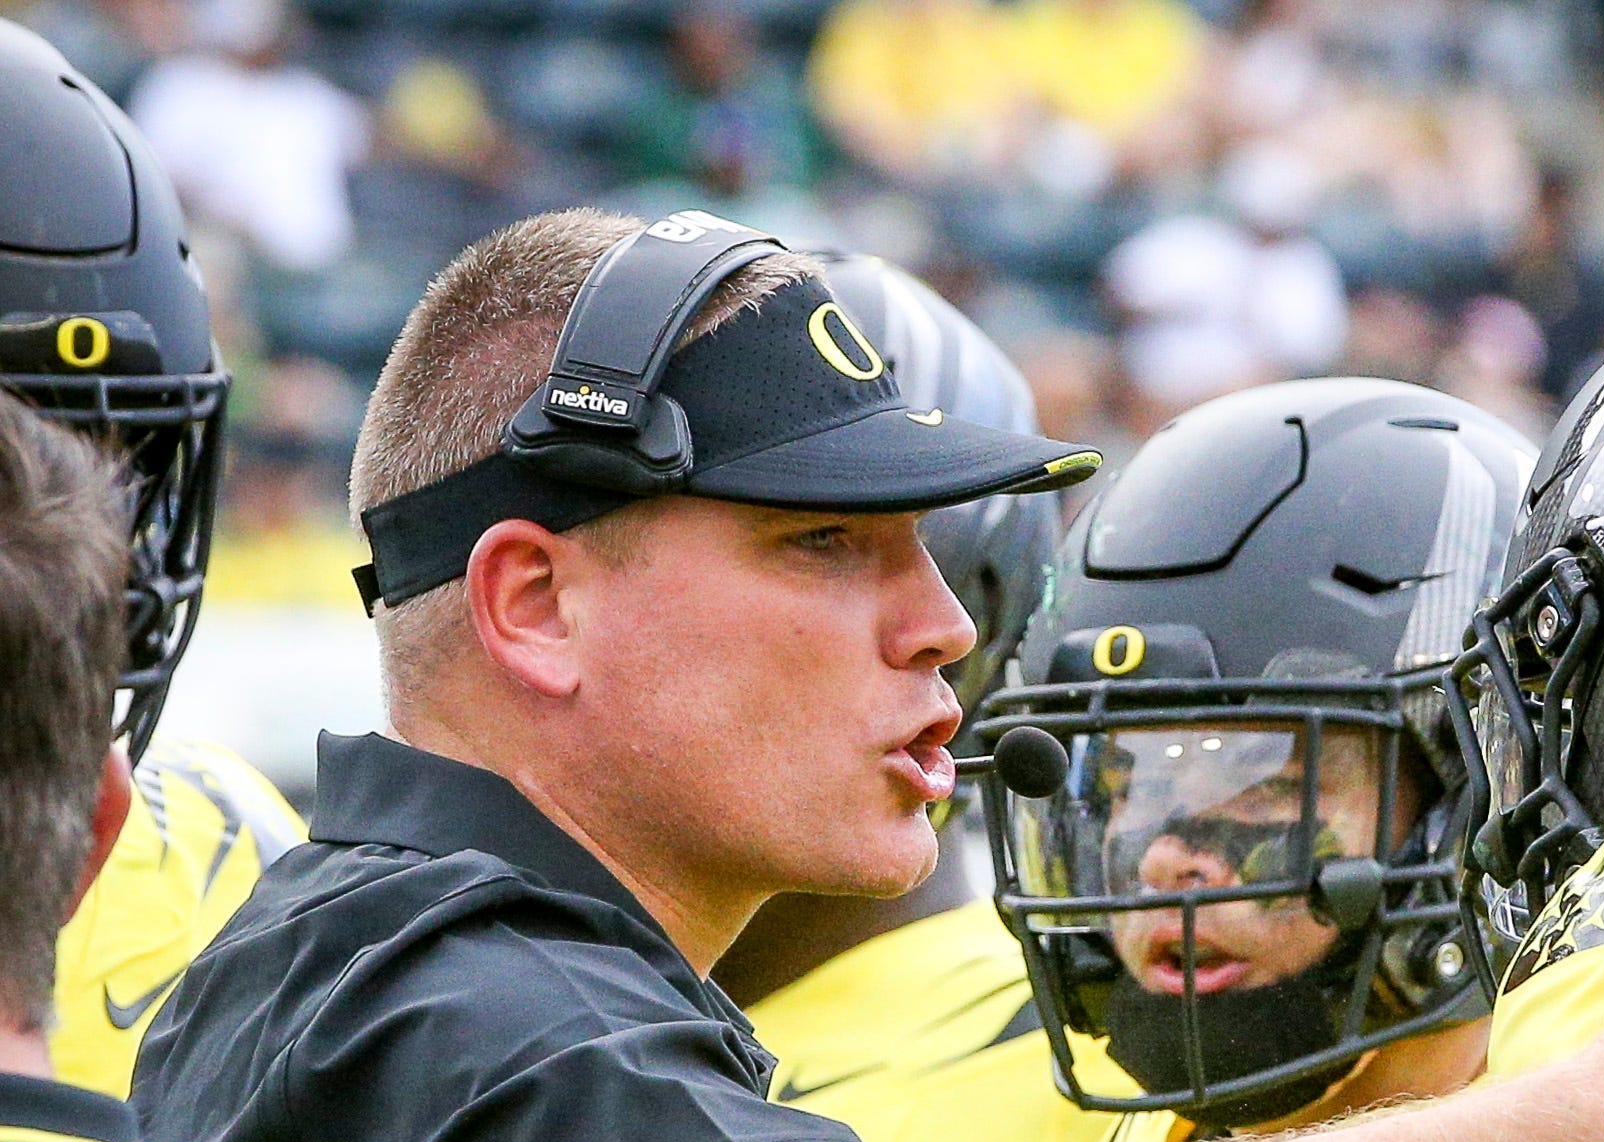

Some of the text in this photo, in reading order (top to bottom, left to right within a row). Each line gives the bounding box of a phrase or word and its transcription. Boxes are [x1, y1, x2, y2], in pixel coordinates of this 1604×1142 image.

[57, 317, 111, 368] O
[807, 301, 884, 381] O
[550, 385, 629, 416] nextiva
[1093, 625, 1147, 676] O
